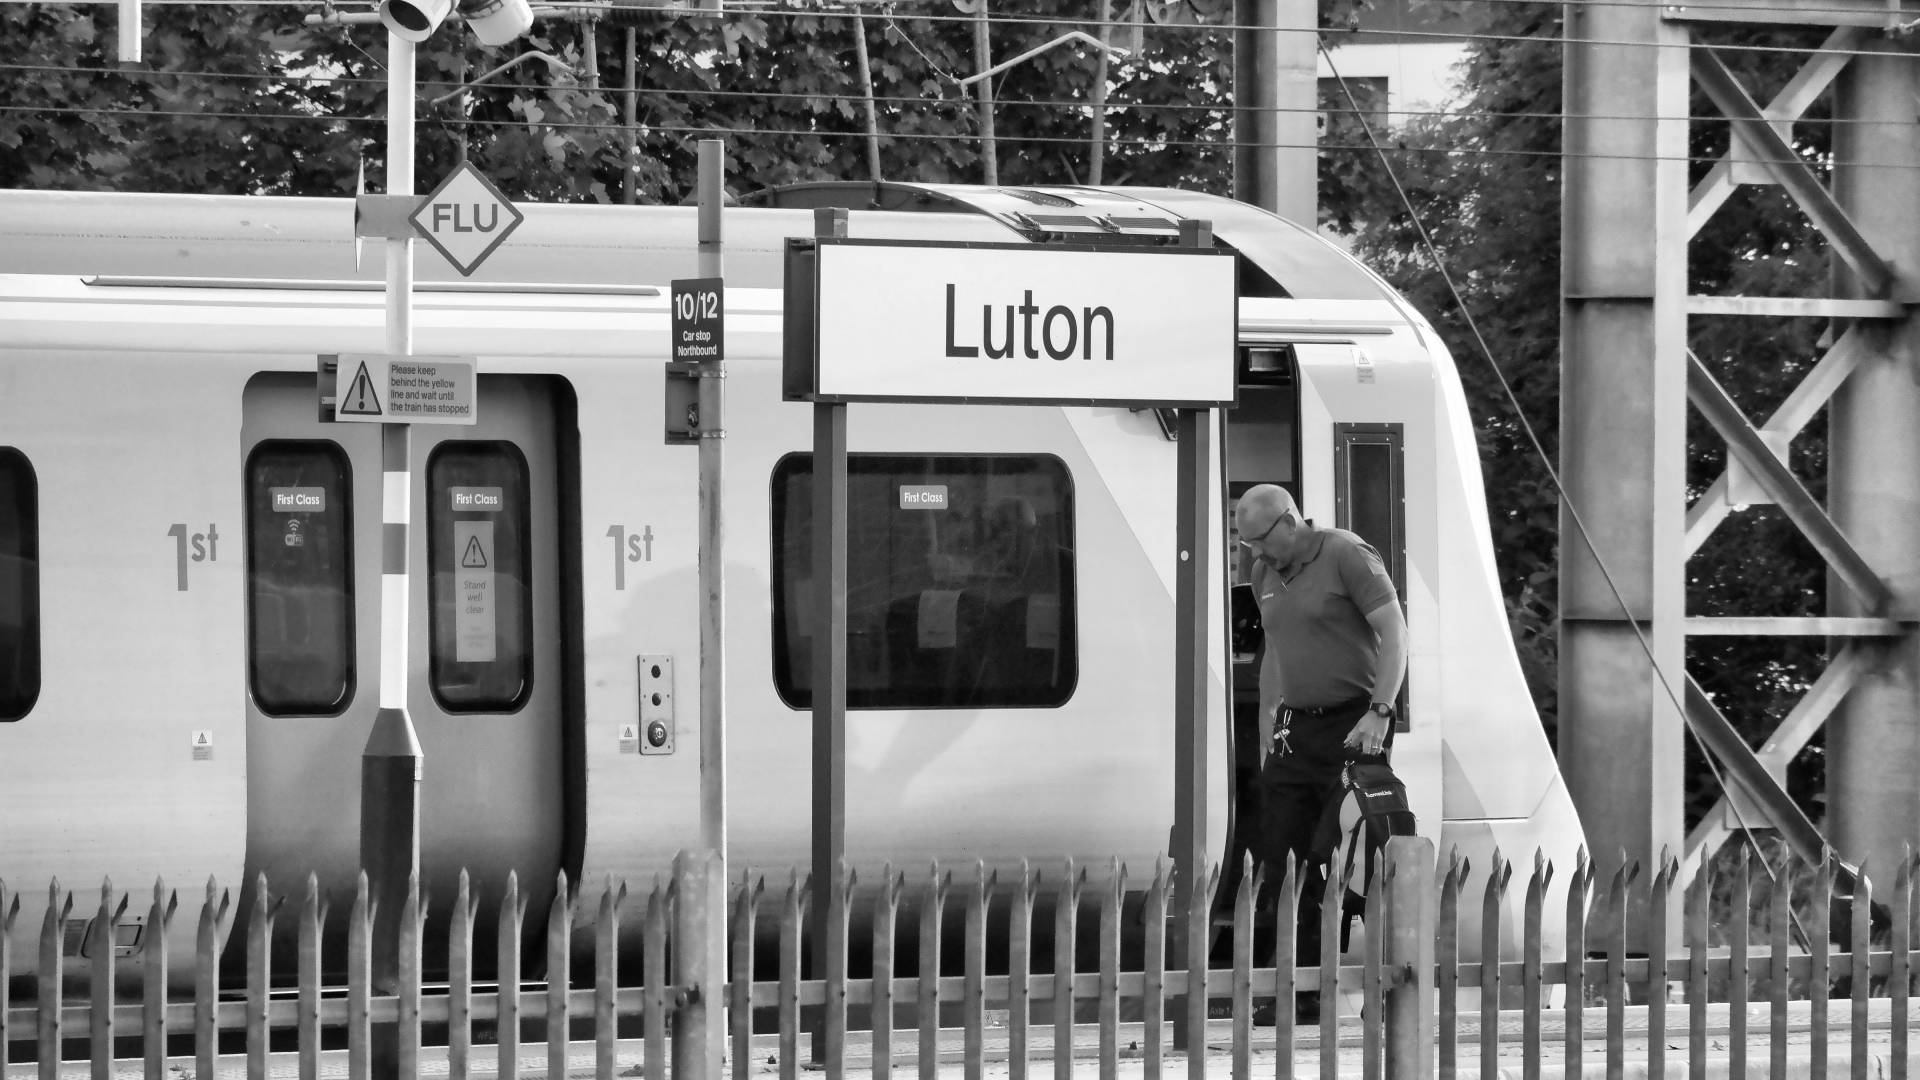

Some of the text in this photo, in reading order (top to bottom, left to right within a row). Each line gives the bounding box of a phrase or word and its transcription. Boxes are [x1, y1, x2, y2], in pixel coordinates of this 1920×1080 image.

[433, 203, 498, 233] FLU
[675, 291, 718, 325] 10/12
[946, 283, 1115, 361] Luton
[682, 330, 711, 342] Car stop
[677, 344, 717, 357] Northbound
[391, 364, 436, 376] Please keep
[391, 377, 455, 389] behind the yellow
[390, 390, 455, 400] line and wait until
[390, 402, 469, 414] the train has stopped
[277, 494, 320, 505] First Class
[456, 493, 498, 504] First Class
[904, 492, 943, 503] First Class
[167, 523, 219, 591] 1st
[606, 524, 654, 591] 1st
[464, 580, 486, 590] Stand
[467, 590, 483, 600] well
[465, 604, 484, 614] clear
